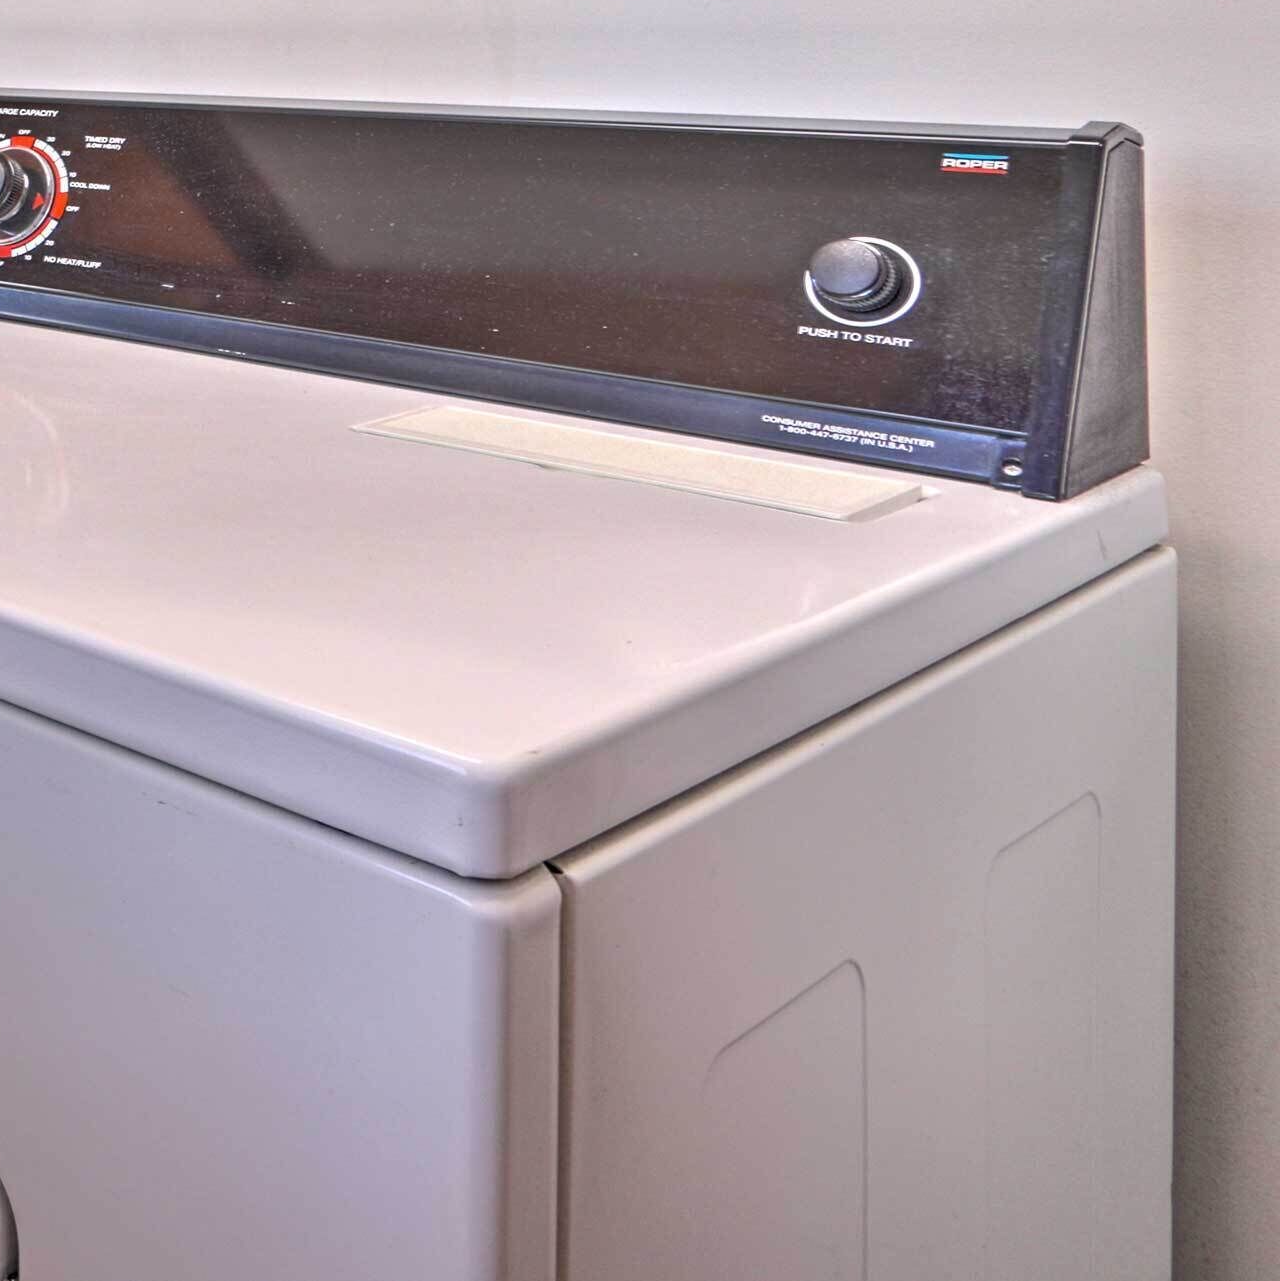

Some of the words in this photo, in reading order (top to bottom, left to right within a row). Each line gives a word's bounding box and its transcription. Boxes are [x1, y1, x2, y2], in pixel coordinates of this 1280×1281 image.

[19, 108, 59, 117] CAPACITY
[84, 135, 108, 143] TIMED
[108, 136, 126, 144] DRY
[942, 158, 1009, 170] ROPER
[69, 181, 87, 189] COOL
[66, 205, 80, 213] OFF
[43, 255, 56, 263] NO
[56, 256, 102, 269] HEAT/FLUFF
[798, 325, 839, 339] PUSH
[840, 331, 862, 342] TO
[864, 333, 914, 348] START
[761, 415, 822, 430] CONSUMER
[822, 425, 889, 440] ASSISTANCE
[889, 434, 936, 448] CENTER
[860, 437, 876, 446] (IN
[876, 440, 914, 453] U.S.A.)
